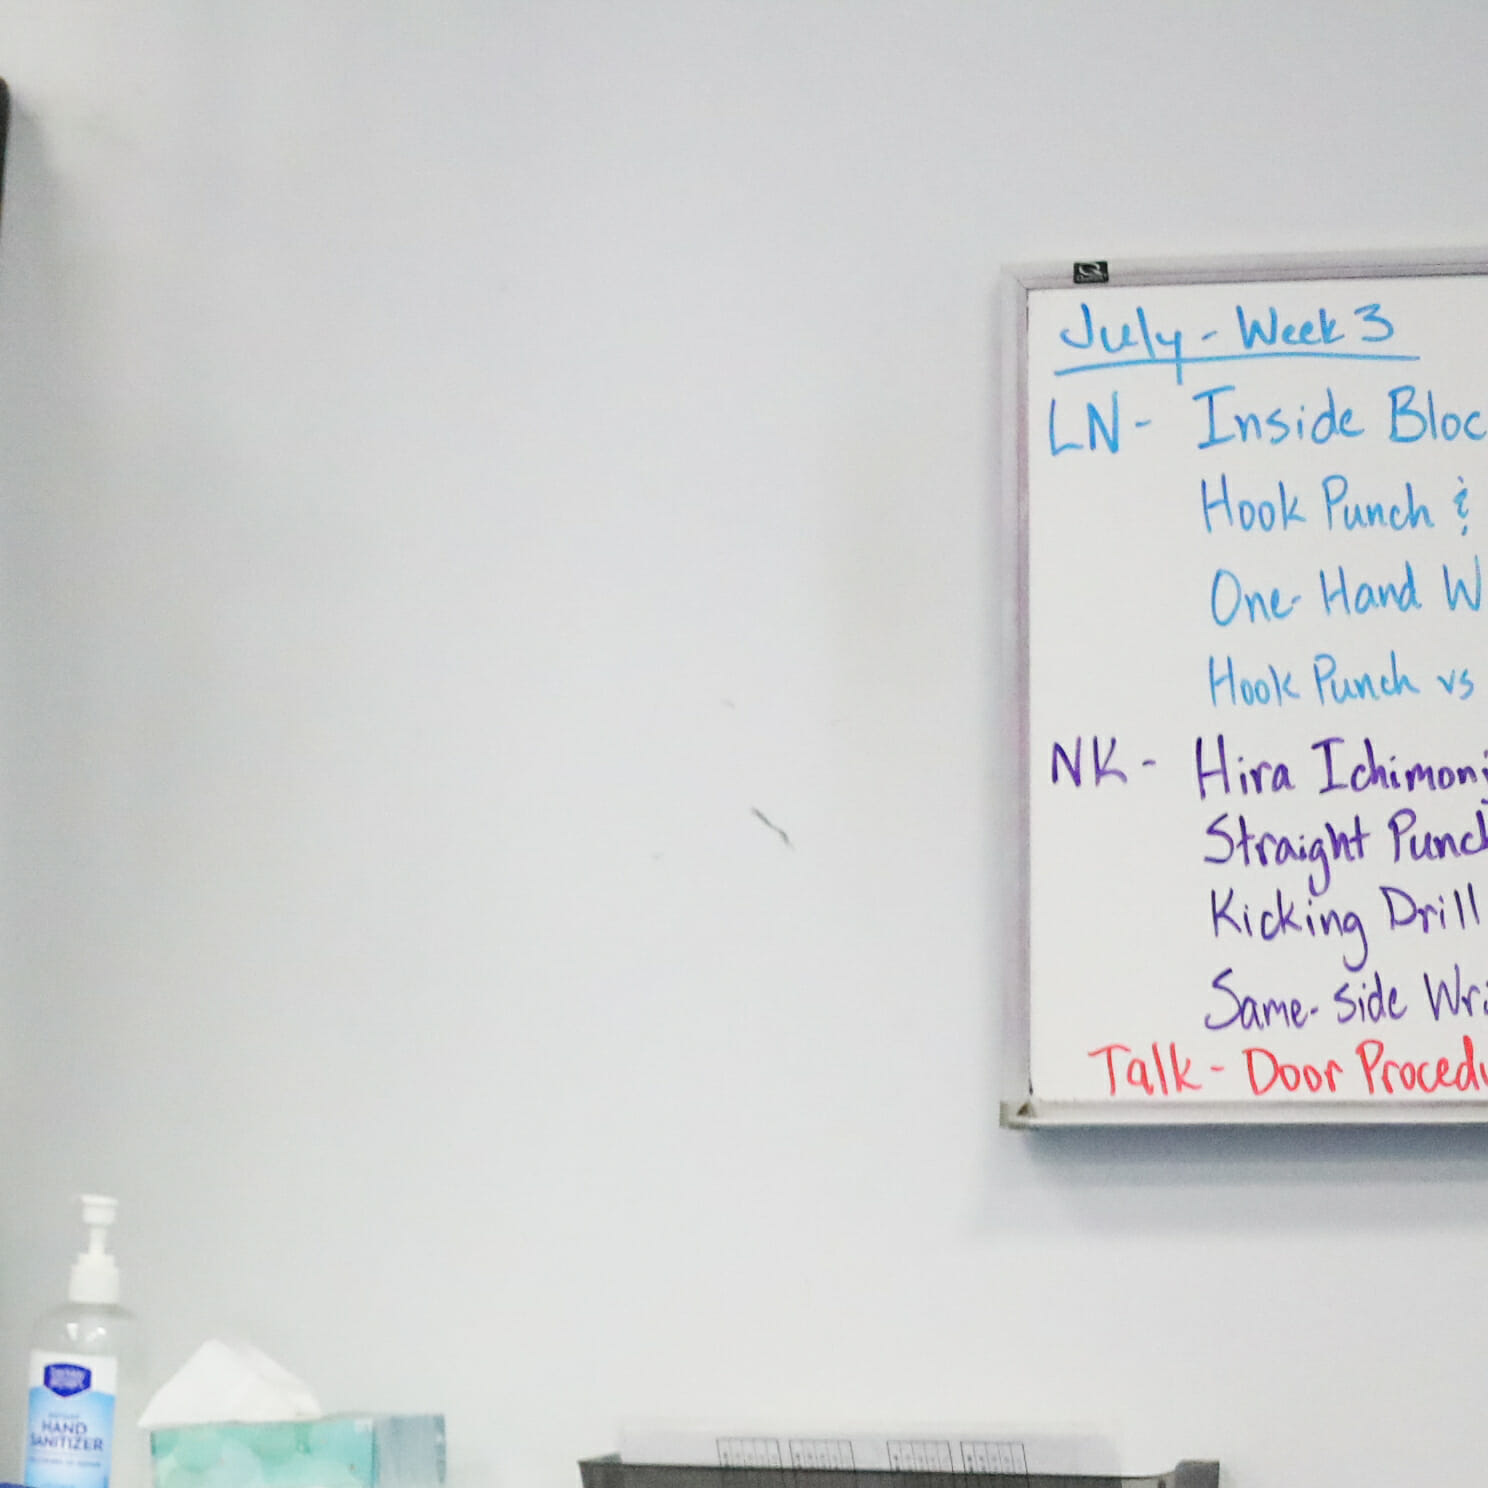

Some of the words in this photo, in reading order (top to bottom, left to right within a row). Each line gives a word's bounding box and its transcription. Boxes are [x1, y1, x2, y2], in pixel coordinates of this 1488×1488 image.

[1060, 302, 1183, 385] July
[1235, 305, 1345, 350] Week
[1353, 303, 1395, 342] 3
[1192, 385, 1364, 450] Inside
[1201, 473, 1307, 533] Hook
[1322, 474, 1435, 532] Punch
[1209, 655, 1301, 707] Hook
[1313, 649, 1420, 706] Punch
[1436, 668, 1475, 701] vs
[1195, 733, 1296, 800] Hira
[1203, 812, 1371, 898] Straight
[1210, 887, 1368, 973] Kicking
[1379, 882, 1481, 934] Drill
[1241, 1045, 1345, 1097] Door
[41, 1420, 88, 1436] HAND
